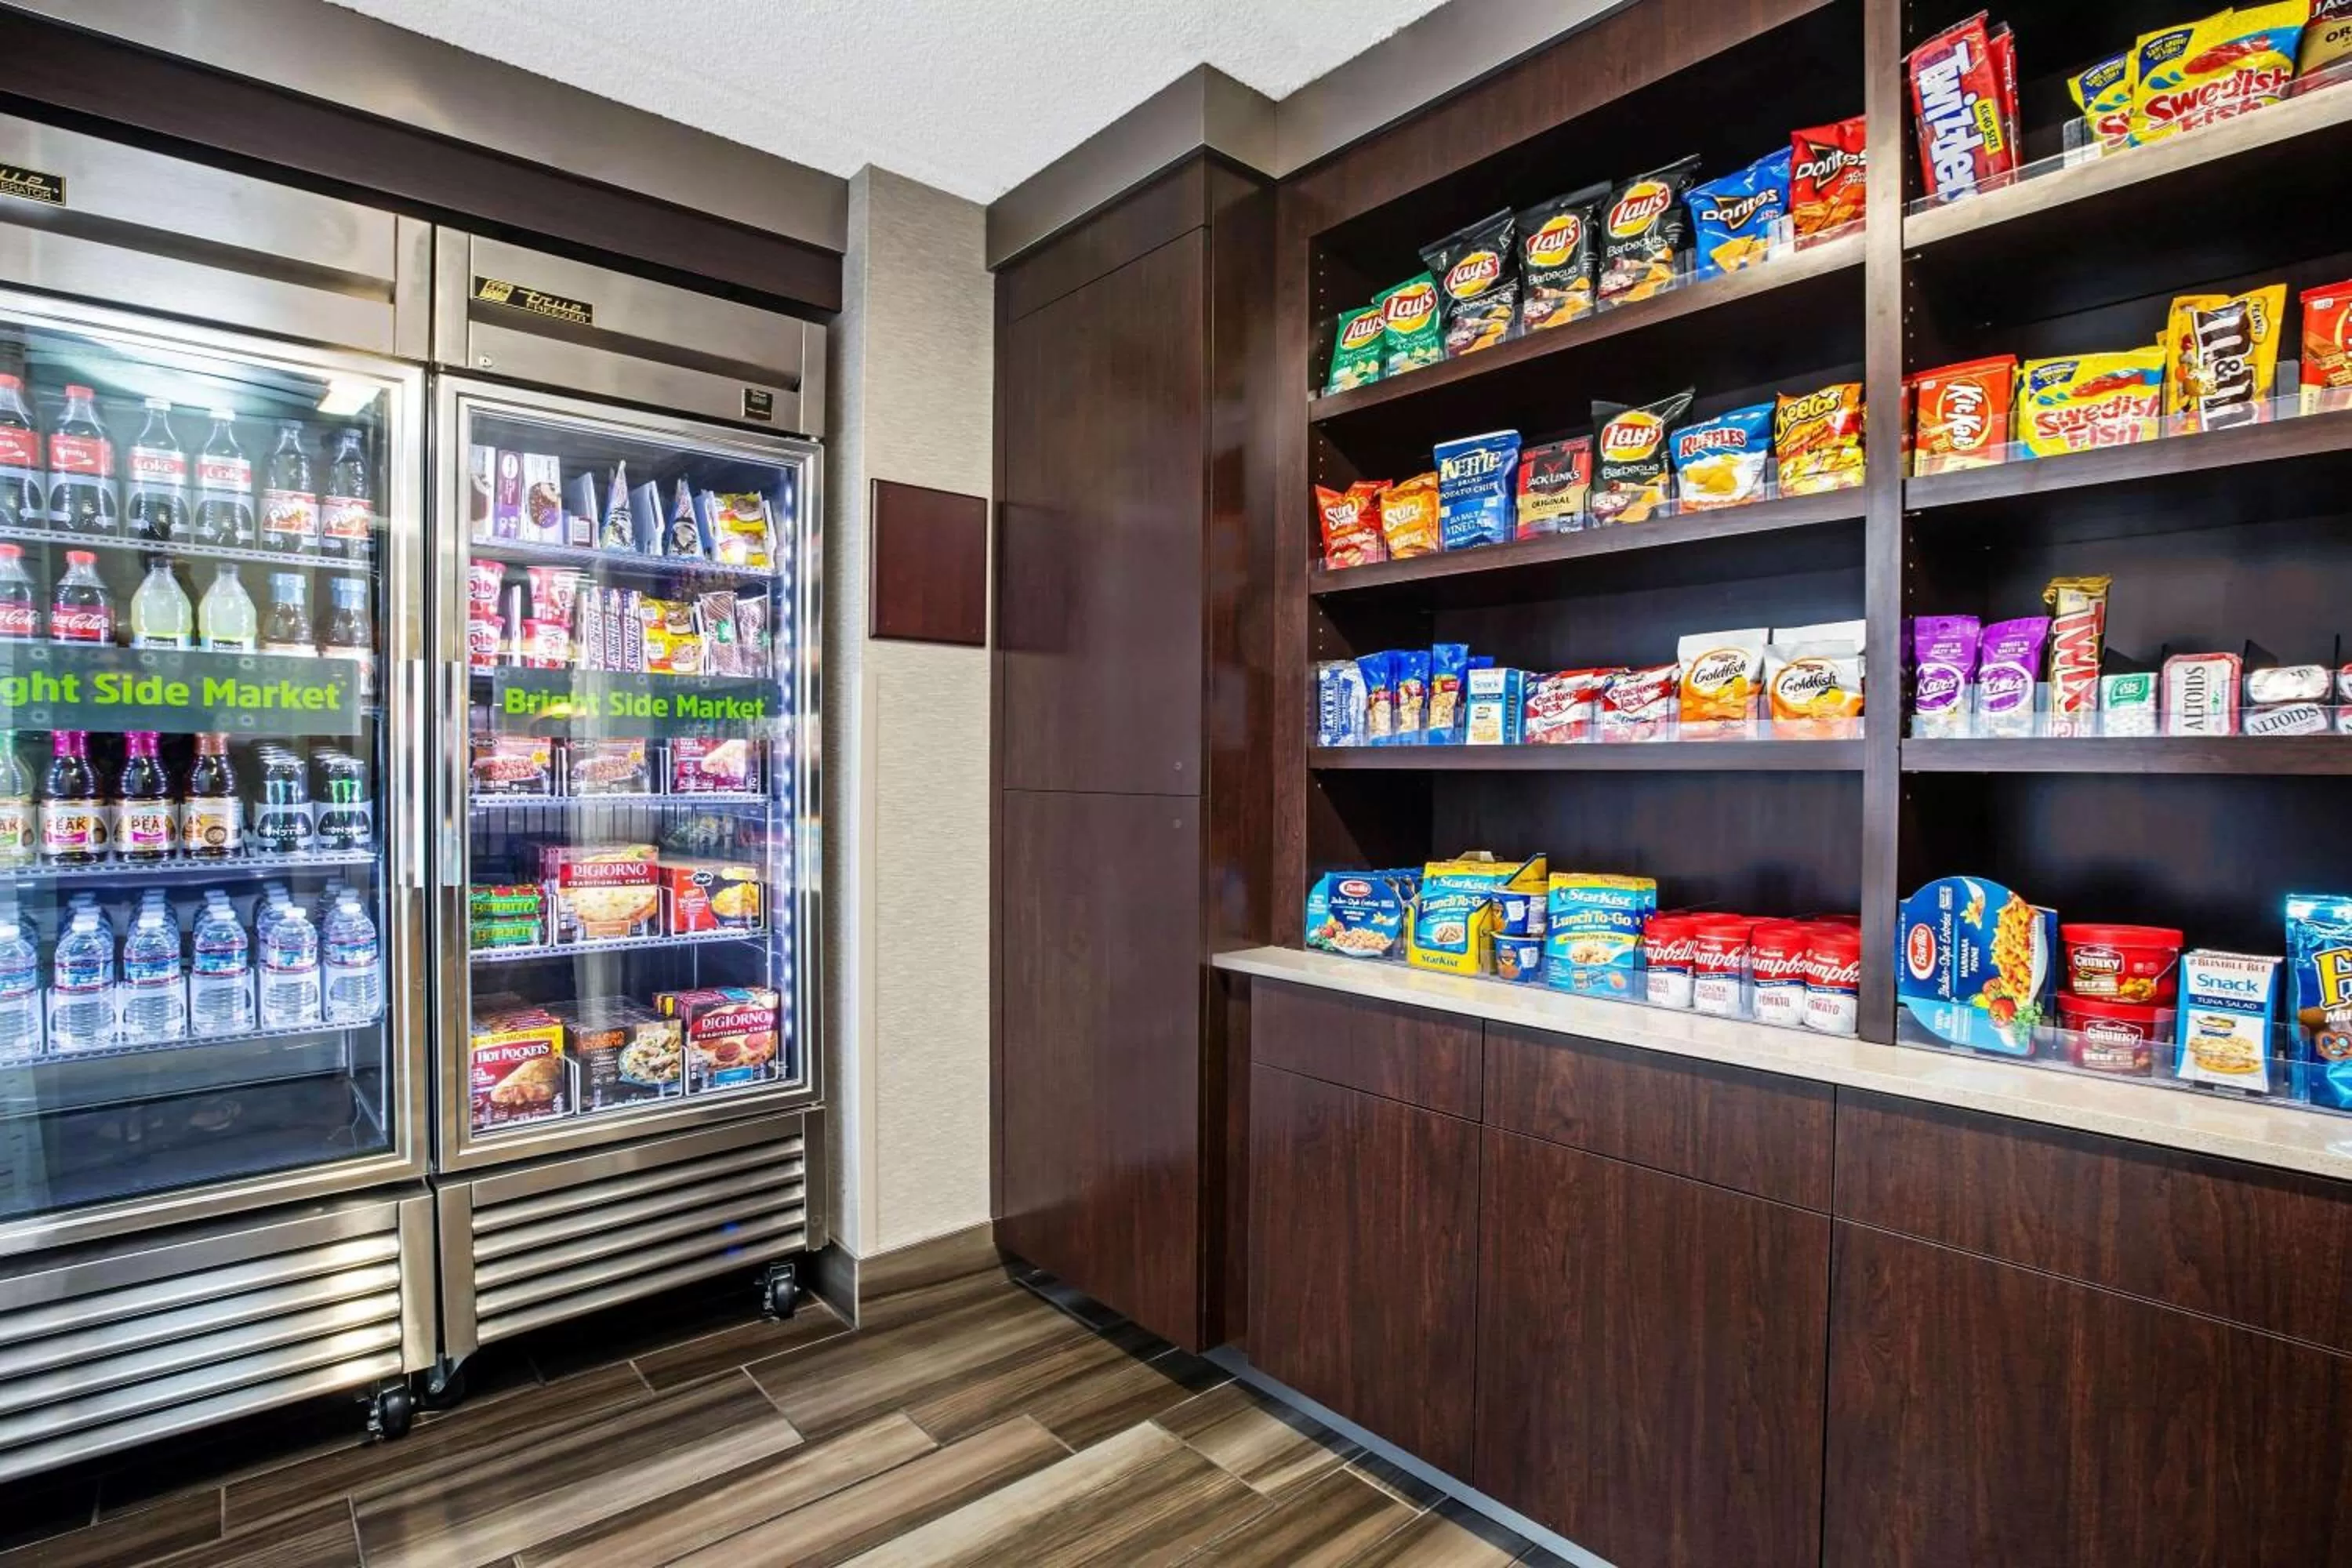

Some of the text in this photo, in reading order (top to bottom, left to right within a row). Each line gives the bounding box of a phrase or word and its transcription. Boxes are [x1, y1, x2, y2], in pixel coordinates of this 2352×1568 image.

[2145, 67, 2291, 122] Swedish
[1979, 103, 1999, 150] KING SIZE
[1795, 148, 1866, 180] Doritos
[1701, 188, 1779, 220] Doritos
[1680, 429, 1746, 457] RUFFLES
[1439, 449, 1503, 481] KETTLE
[1602, 464, 1660, 480] Barbecue
[1457, 476, 1483, 486] BRAND
[1526, 474, 1549, 488] JACK
[1531, 496, 1570, 509] ORIGINAL
[1325, 503, 1358, 530] Sun
[1385, 503, 1421, 532] Sun
[2056, 601, 2105, 712] TWIX
[1694, 659, 1747, 684] Goldfish
[1780, 670, 1837, 691] Goldfish
[94, 673, 189, 706] Side
[204, 677, 340, 710] Market
[2184, 666, 2205, 731] ALTOIDS
[608, 690, 669, 717] Side
[677, 694, 765, 719] Market
[2251, 706, 2318, 734] ALTOIDS
[572, 864, 648, 877] DIGIORNO
[1440, 876, 1488, 891] StarKist
[1568, 888, 1632, 907] StarKist
[1550, 909, 1592, 929] Lunch
[1421, 953, 1458, 967] StarKist
[2197, 956, 2267, 972] BUMBLE BEE
[2196, 973, 2259, 993] Snack
[2197, 996, 2257, 1010] TUNA SALAD
[702, 1010, 768, 1029] DIGIORNO
[477, 1051, 500, 1063] HOT
